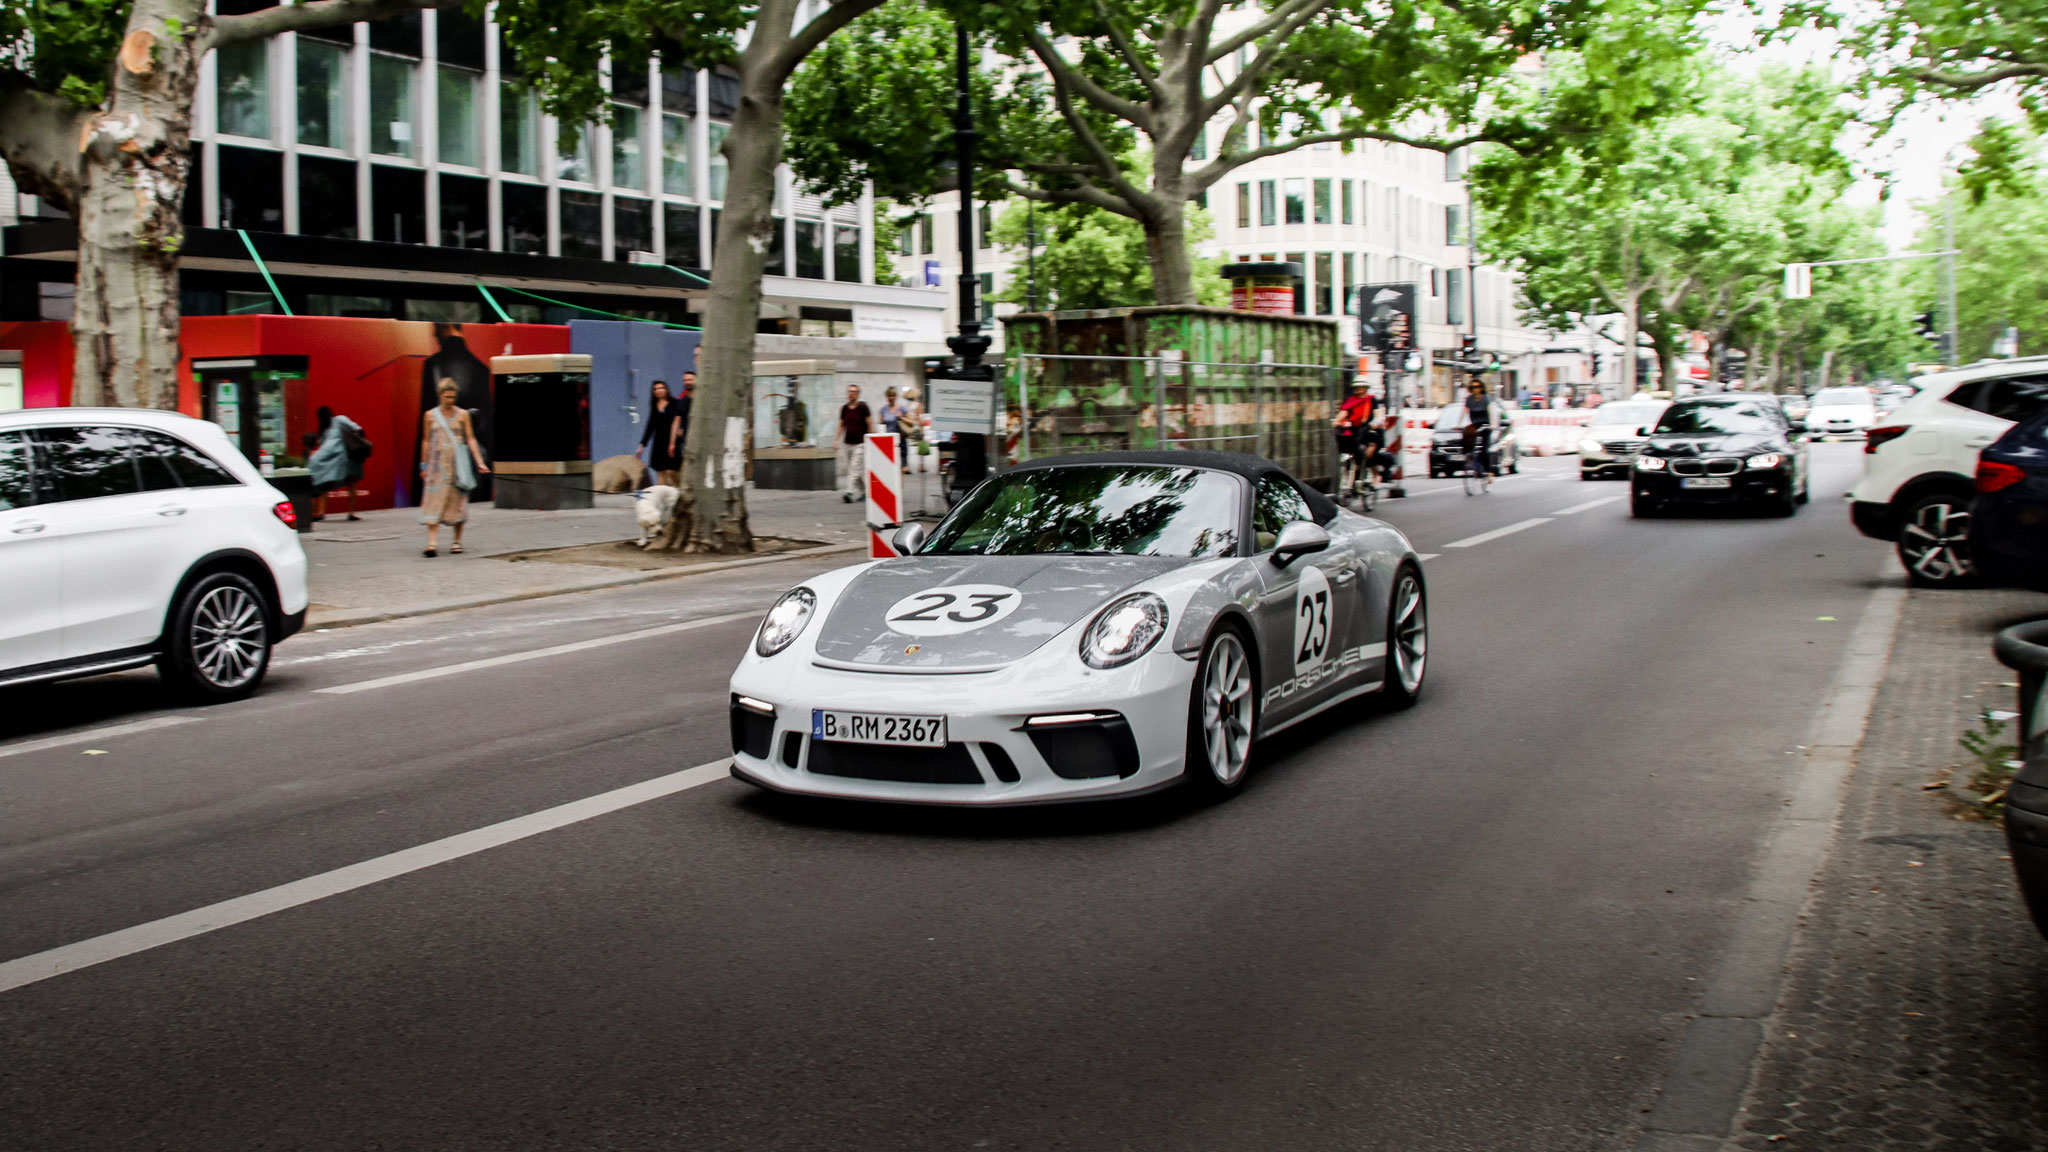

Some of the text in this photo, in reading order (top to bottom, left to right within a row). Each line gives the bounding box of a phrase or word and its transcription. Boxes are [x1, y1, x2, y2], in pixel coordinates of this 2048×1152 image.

[888, 593, 1013, 623] 23
[1296, 590, 1328, 665] 23
[1266, 647, 1360, 706] PORSCHE
[824, 713, 941, 743] B RM 2367
